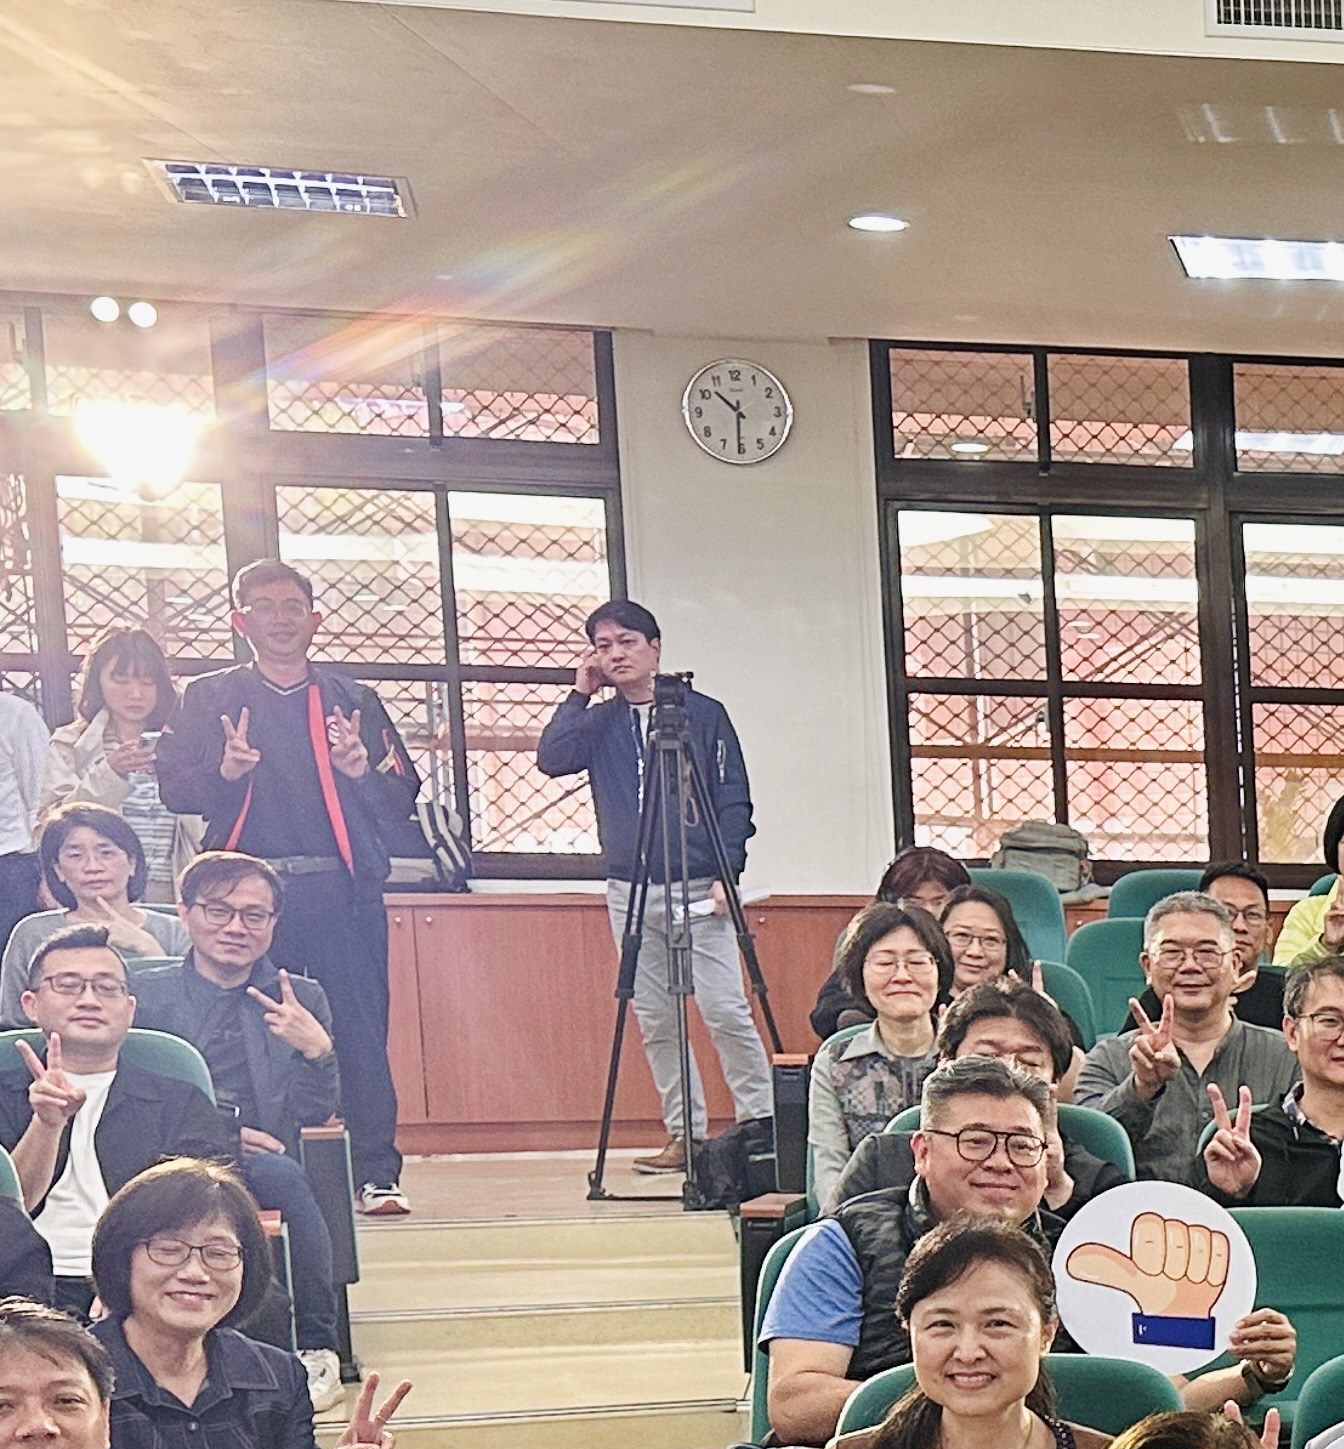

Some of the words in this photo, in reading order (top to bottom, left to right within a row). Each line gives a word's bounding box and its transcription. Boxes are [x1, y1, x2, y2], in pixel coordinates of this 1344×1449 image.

[711, 375, 721, 387] 11
[728, 369, 741, 382] 12
[751, 374, 758, 386] 1
[699, 388, 712, 400] 10
[765, 387, 774, 399] 2
[694, 406, 703, 418] 9
[773, 406, 782, 418] 3
[703, 426, 712, 438] 8
[769, 426, 777, 437] 4
[720, 439, 727, 450] 7
[756, 438, 764, 450] 5
